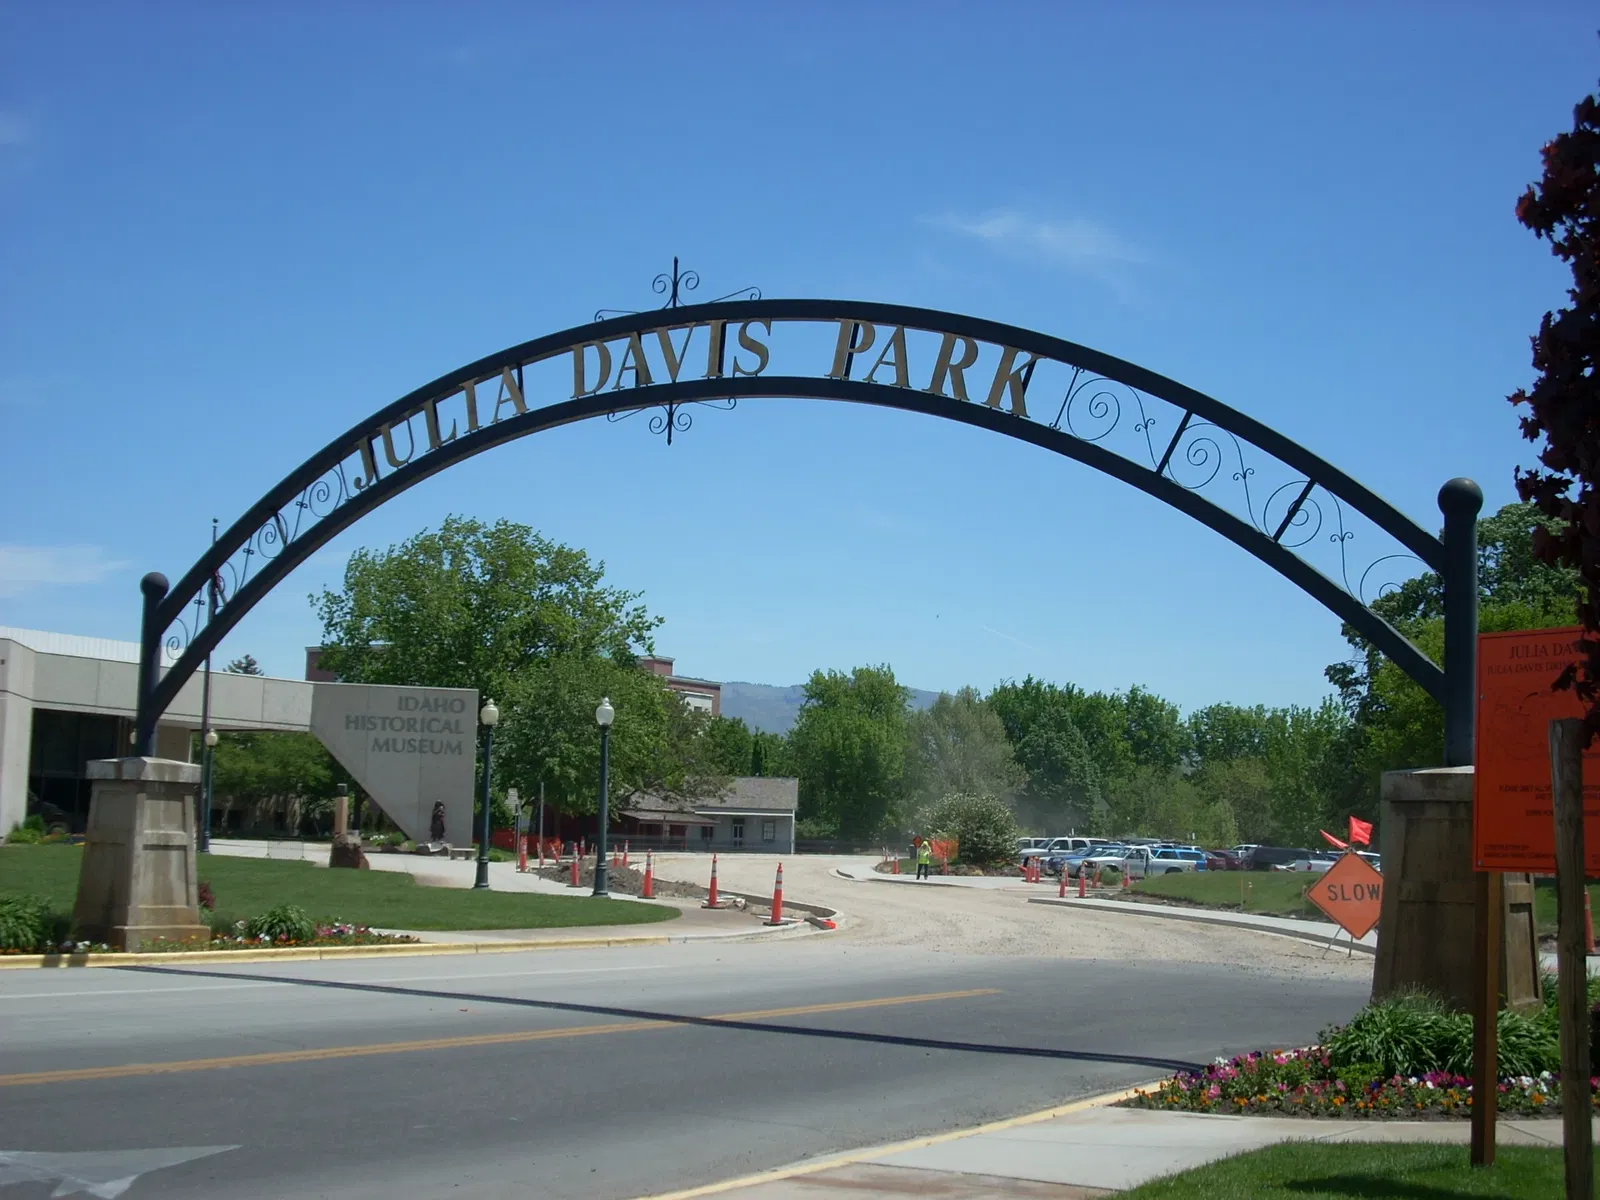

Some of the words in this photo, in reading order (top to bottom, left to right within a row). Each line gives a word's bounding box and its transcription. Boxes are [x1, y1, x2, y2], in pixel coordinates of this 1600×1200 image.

[354, 365, 529, 490] JULIA
[570, 318, 772, 399] DAVIS
[825, 318, 1047, 418] PARK
[1509, 643, 1548, 659] JULIA
[398, 696, 465, 713] IDAHO
[344, 714, 464, 735] HISTORICAL
[371, 737, 462, 756] MUSEUM
[1327, 884, 1380, 902] SLOW
